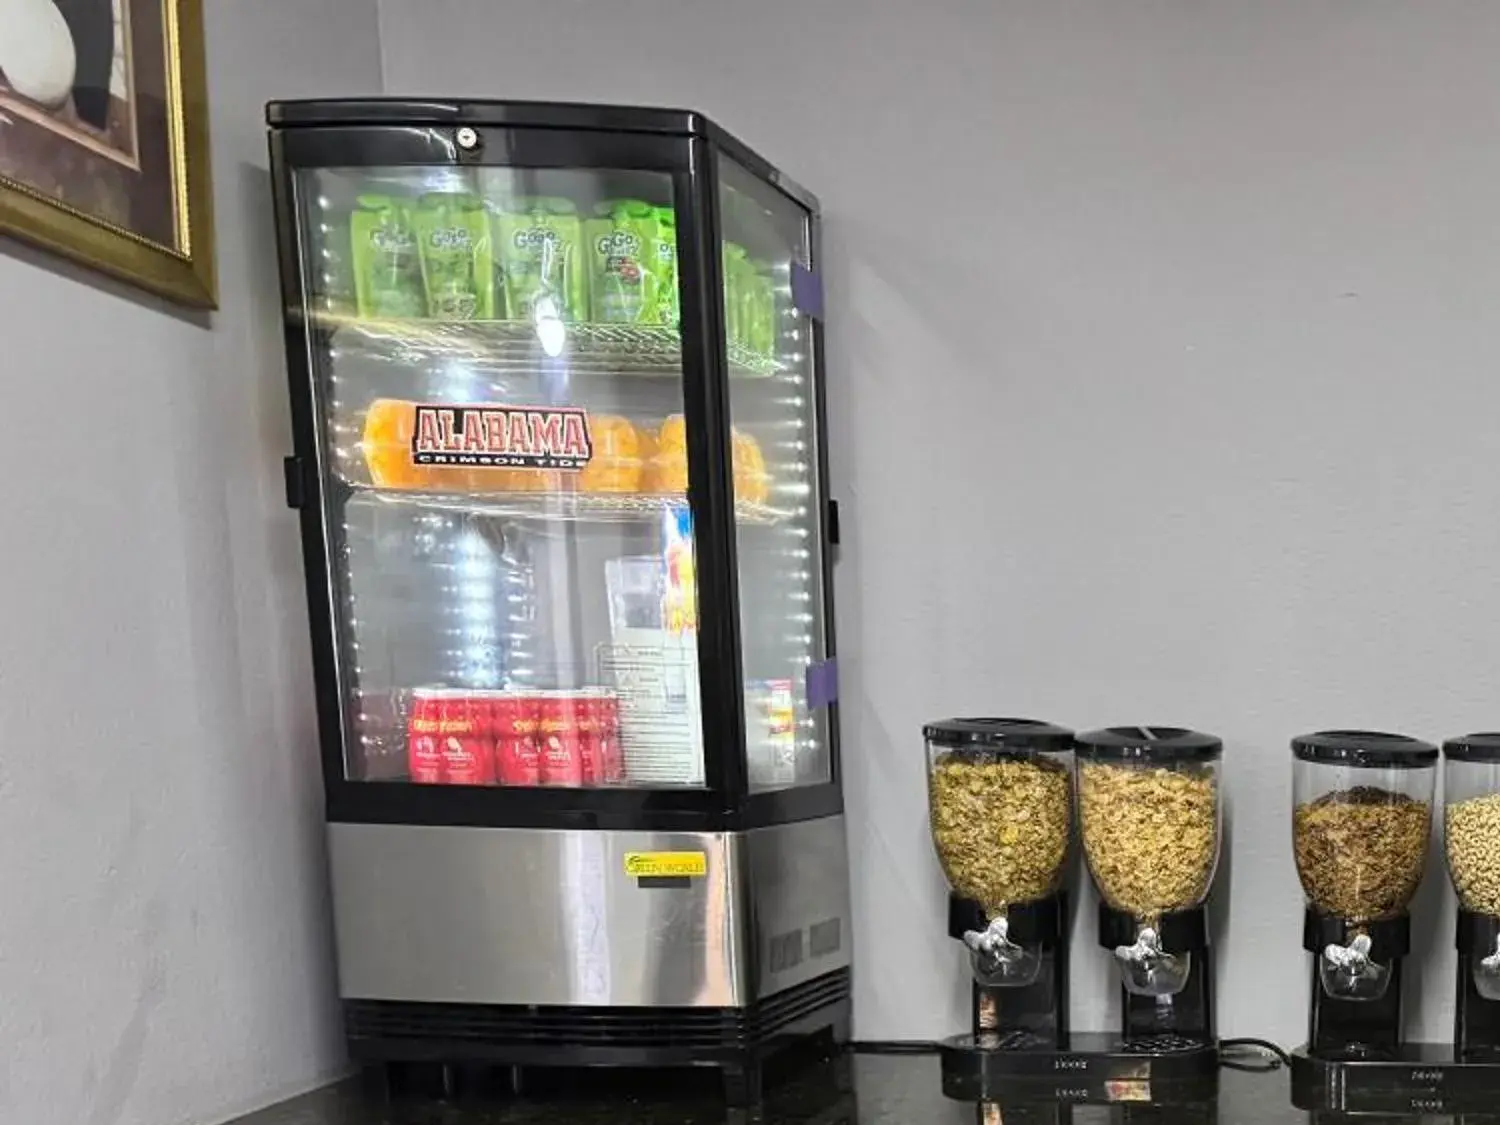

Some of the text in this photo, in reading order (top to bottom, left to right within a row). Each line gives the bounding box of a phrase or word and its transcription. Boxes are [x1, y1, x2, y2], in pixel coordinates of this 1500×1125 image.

[417, 408, 590, 459] ALABAMA
[418, 454, 588, 468] CRIMSON TIDE
